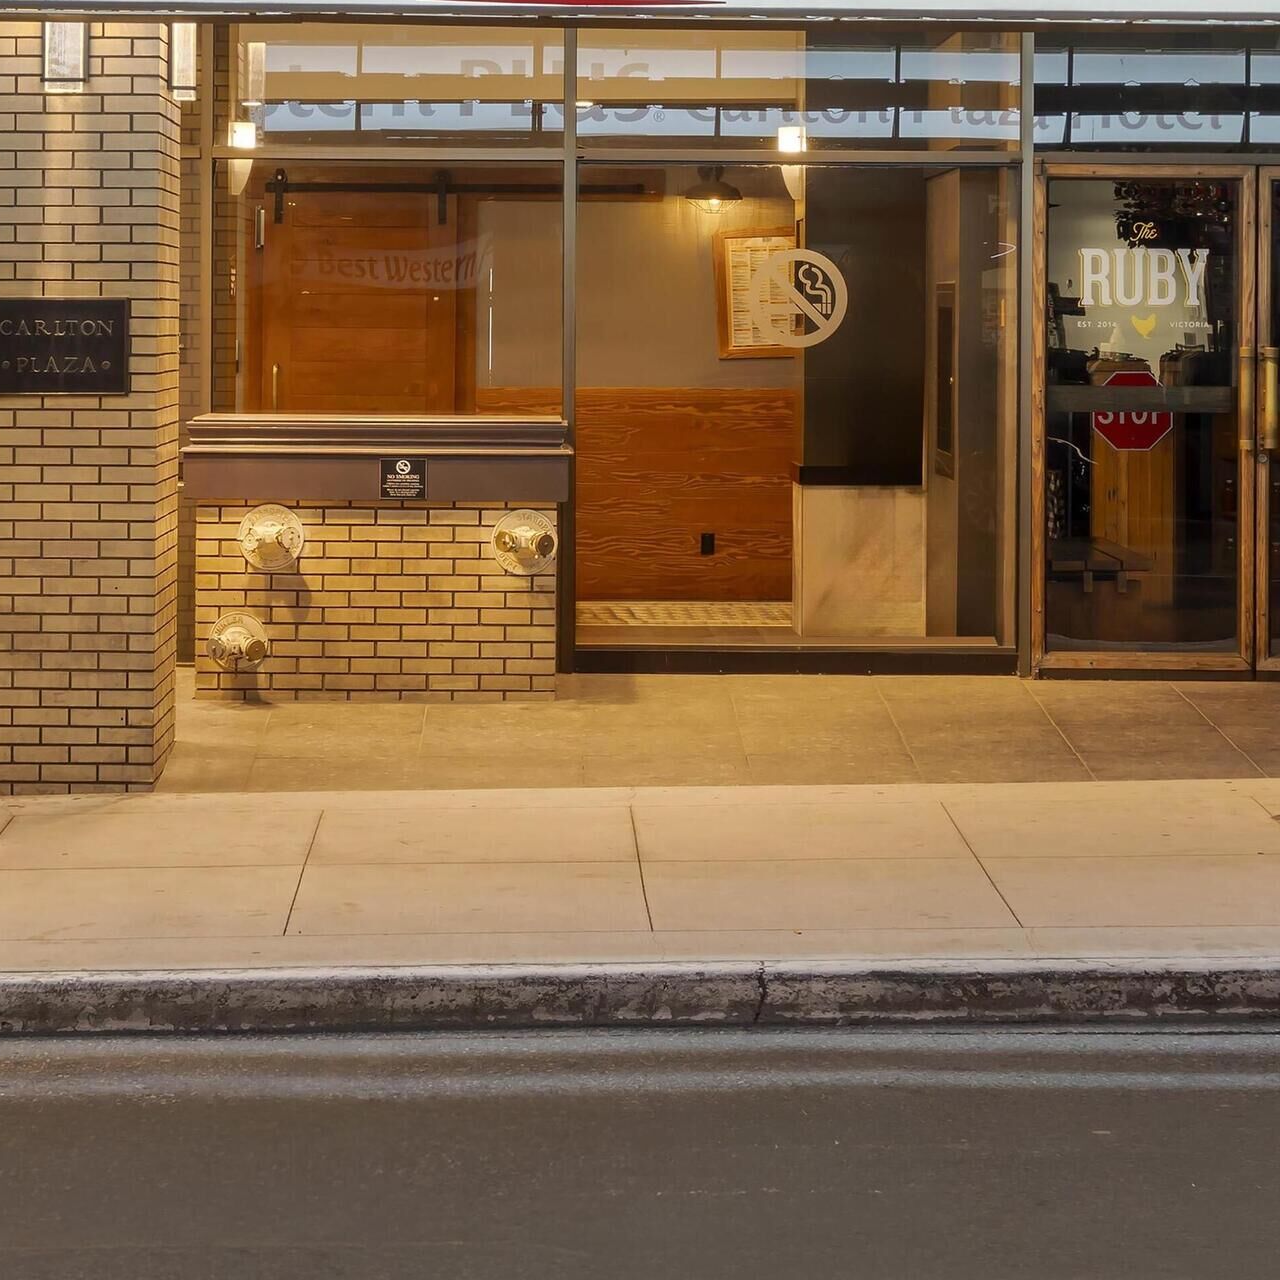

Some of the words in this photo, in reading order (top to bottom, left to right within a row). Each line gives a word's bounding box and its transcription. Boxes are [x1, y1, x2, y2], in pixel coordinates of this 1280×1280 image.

[1129, 222, 1158, 242] The
[1077, 247, 1210, 308] RUBY
[0, 319, 115, 336] CARLTON
[16, 356, 97, 373] PLAZA
